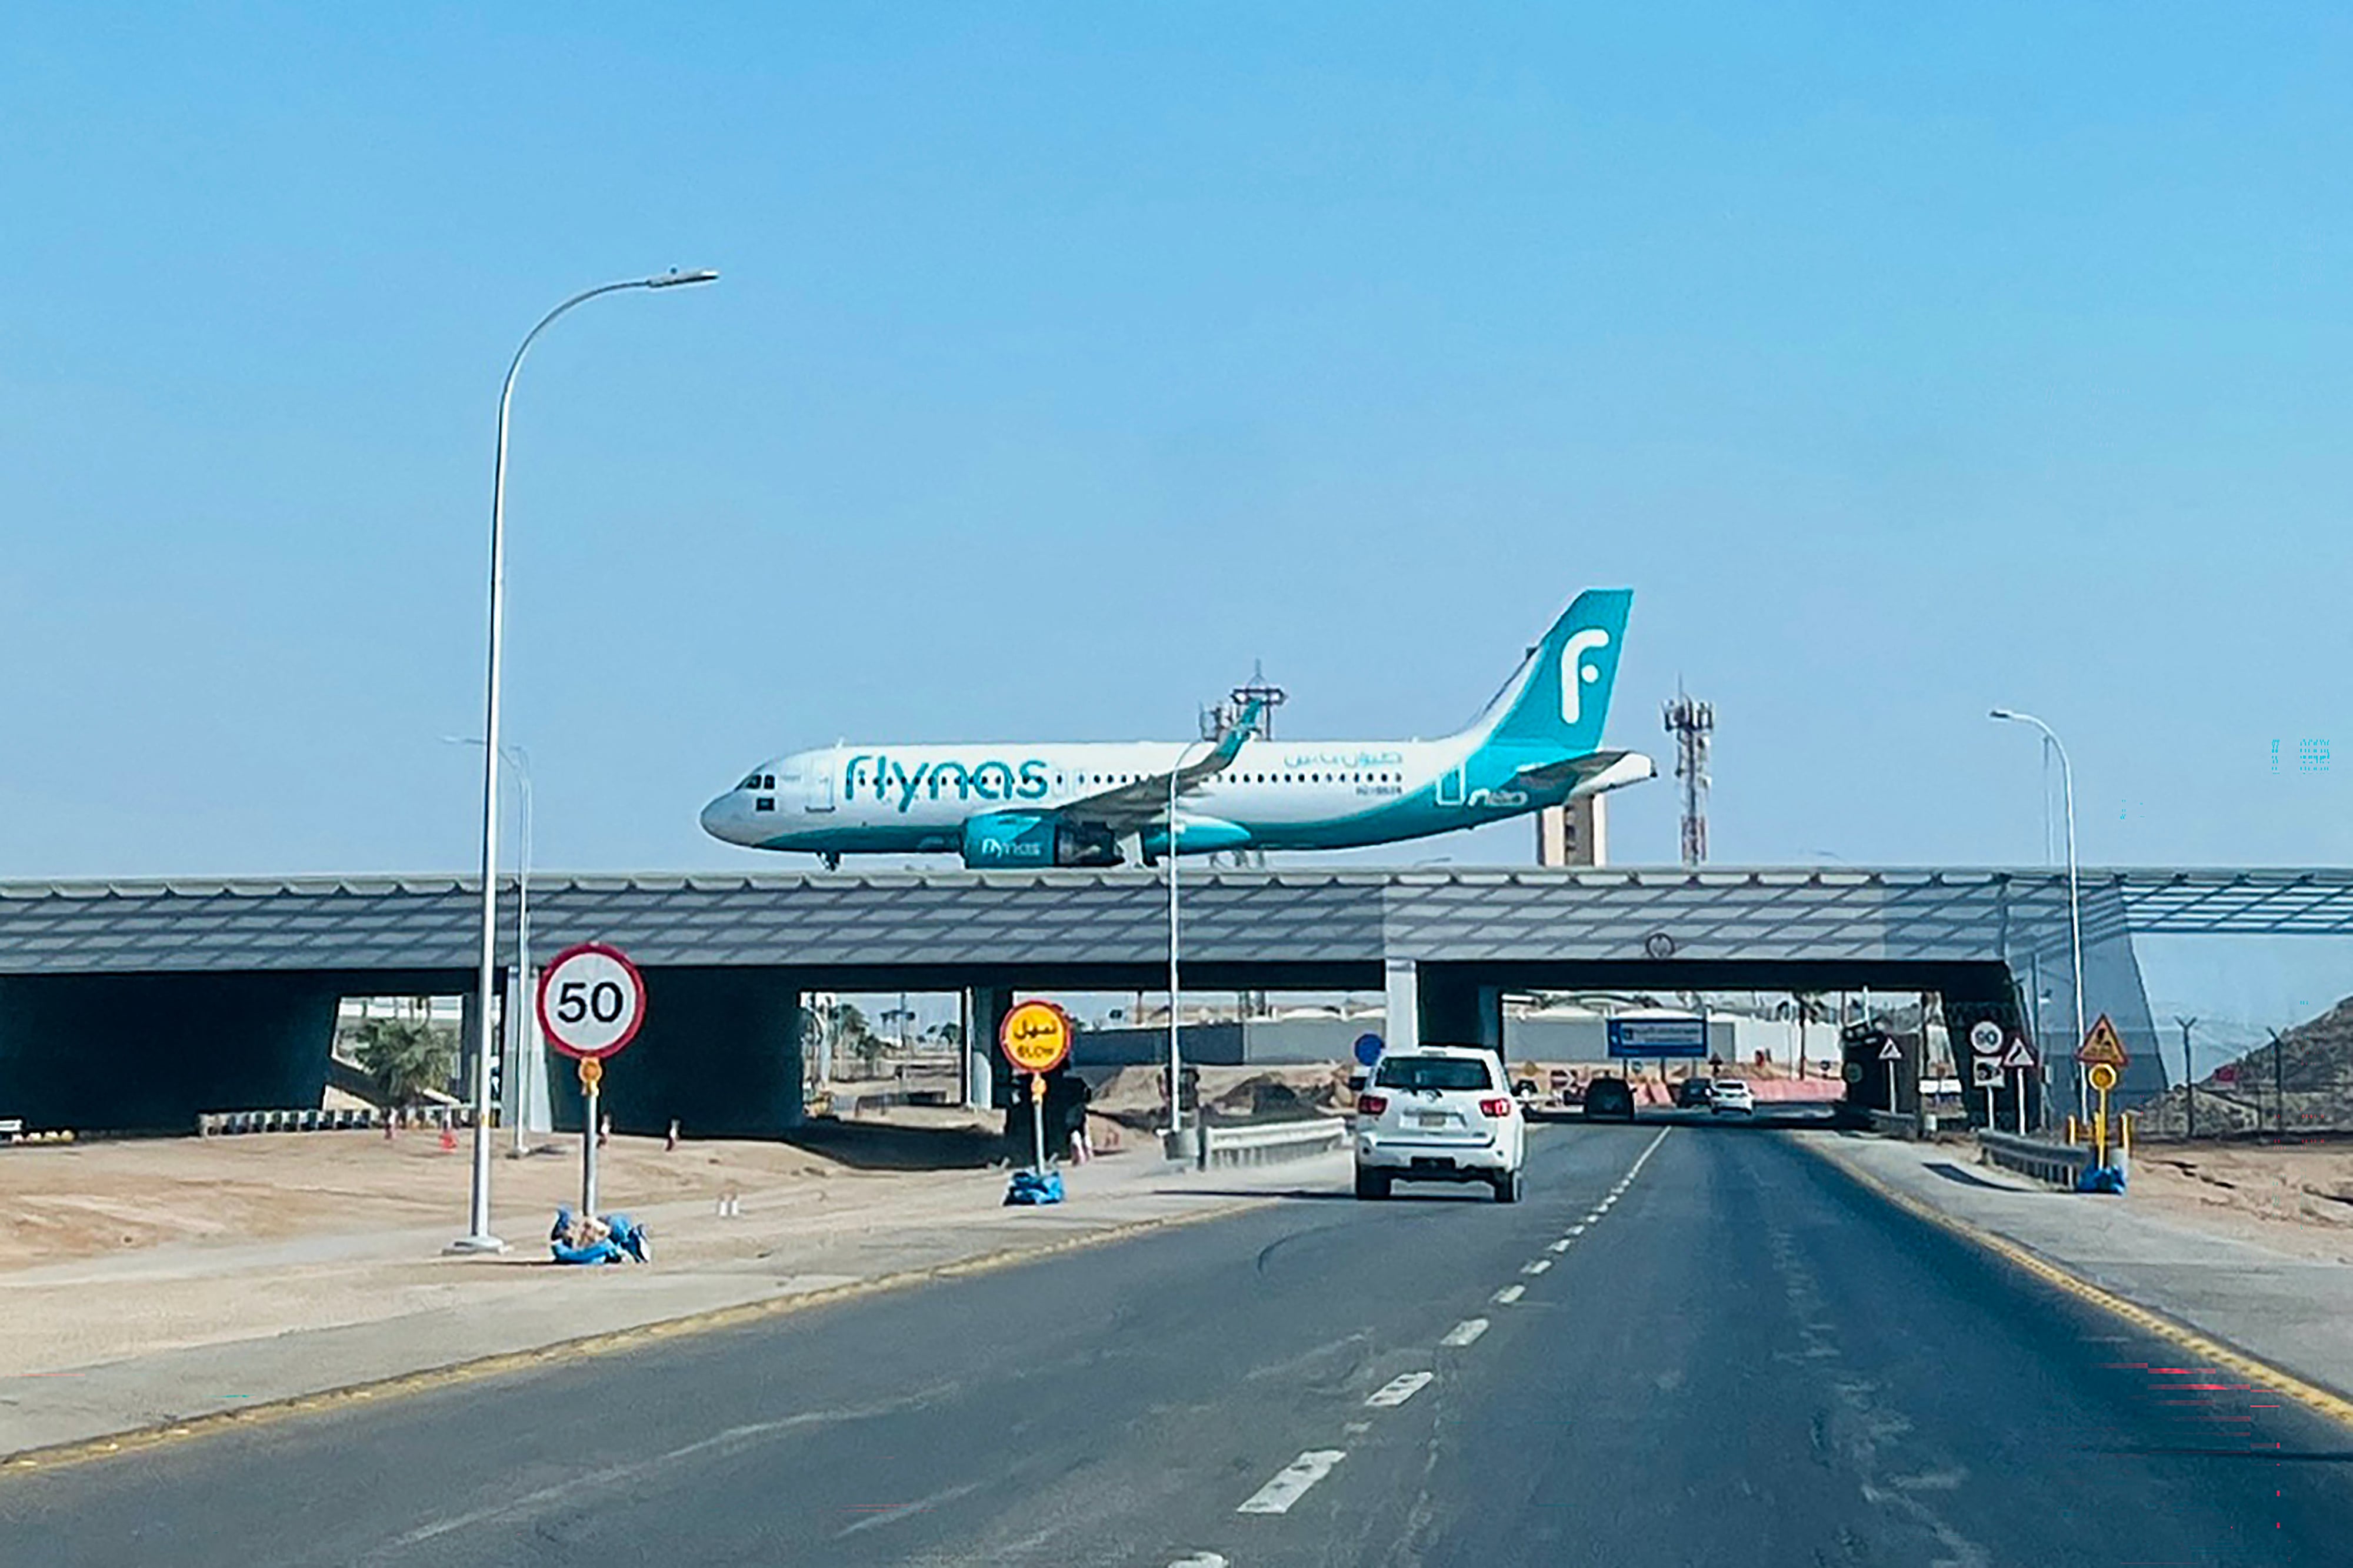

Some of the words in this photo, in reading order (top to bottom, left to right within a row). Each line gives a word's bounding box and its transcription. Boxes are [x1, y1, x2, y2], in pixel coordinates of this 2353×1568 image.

[845, 755, 1048, 813] flynas
[558, 982, 624, 1023] 50
[1016, 1045, 1054, 1058] SLOW
